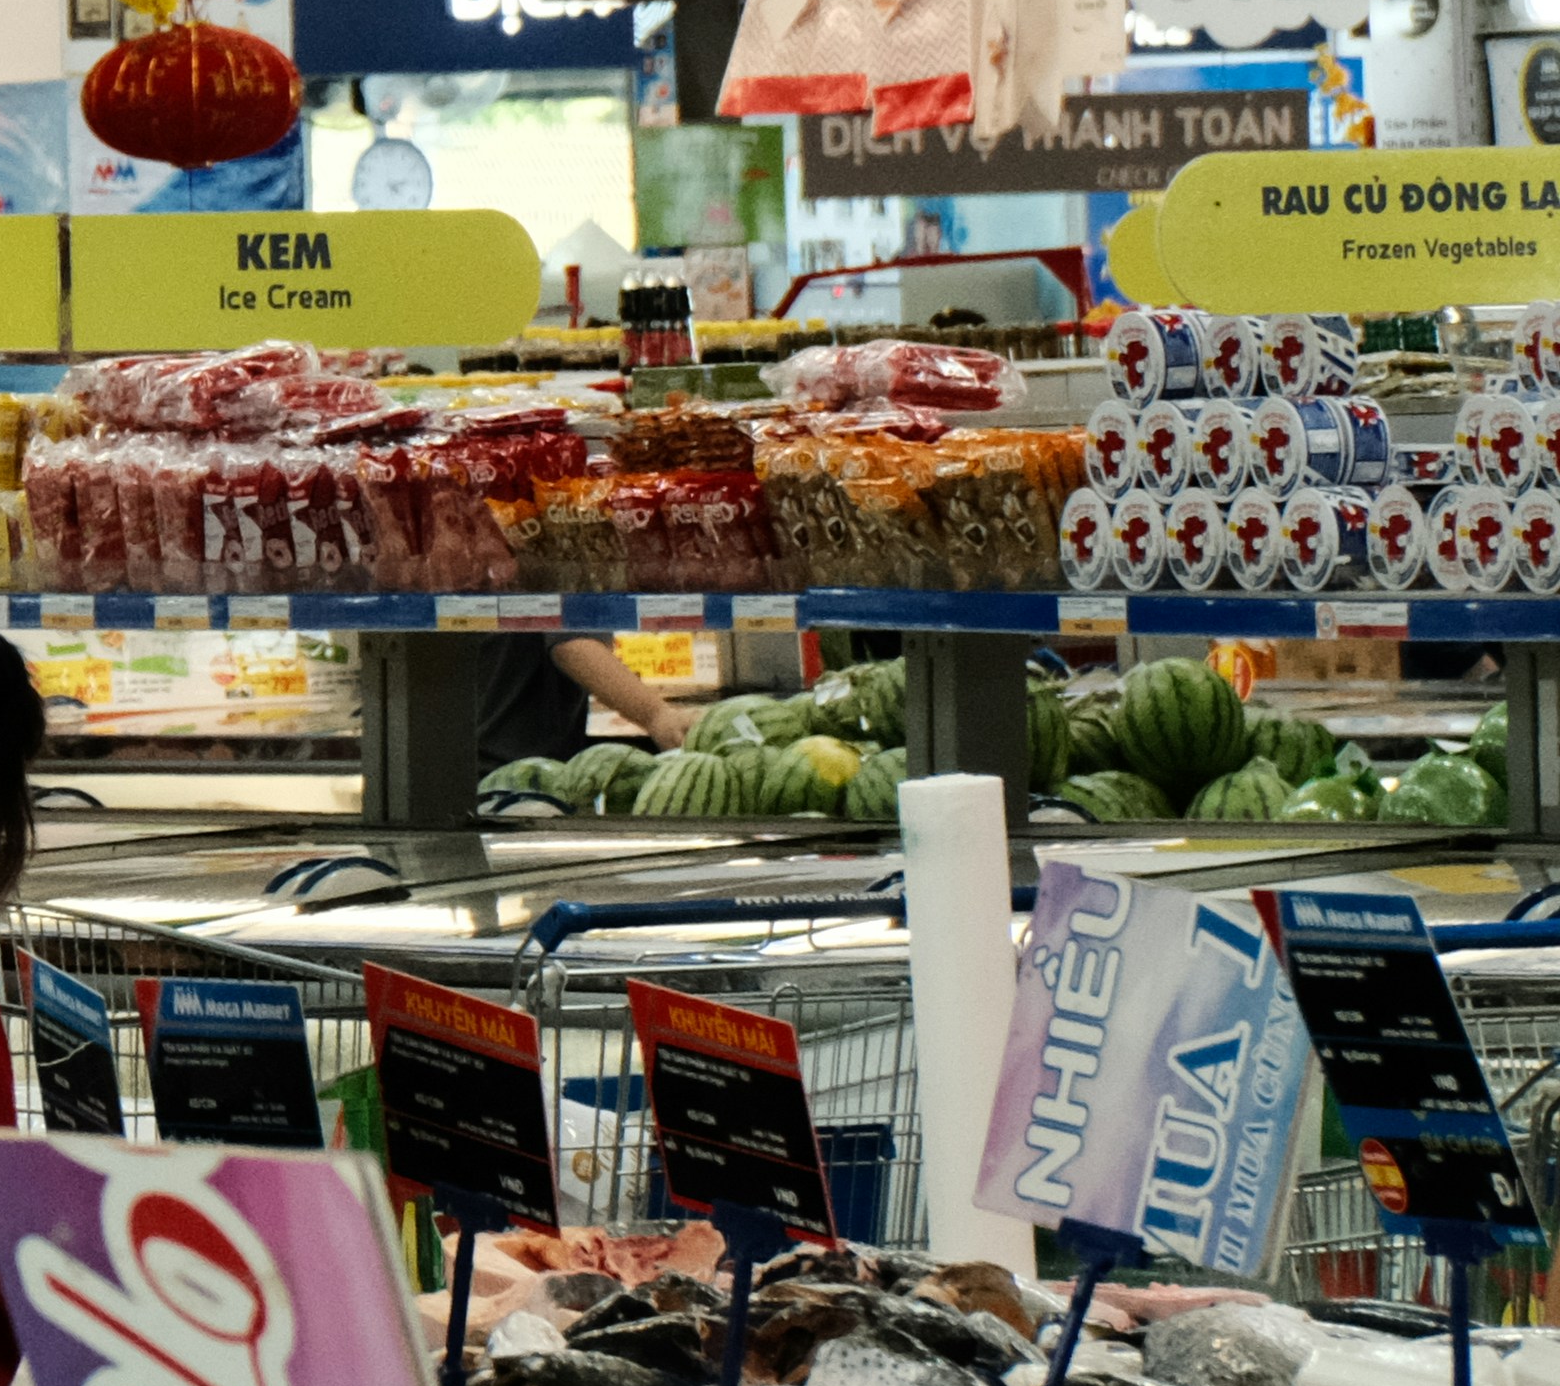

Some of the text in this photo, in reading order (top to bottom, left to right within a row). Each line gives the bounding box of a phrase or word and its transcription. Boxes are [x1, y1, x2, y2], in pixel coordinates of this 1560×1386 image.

[1261, 173, 1507, 216] RAU CỦ ĐÔNG
[237, 233, 332, 271] KEM
[1342, 236, 1538, 264] Frozen Vegetables
[219, 285, 352, 311] Ice Cream
